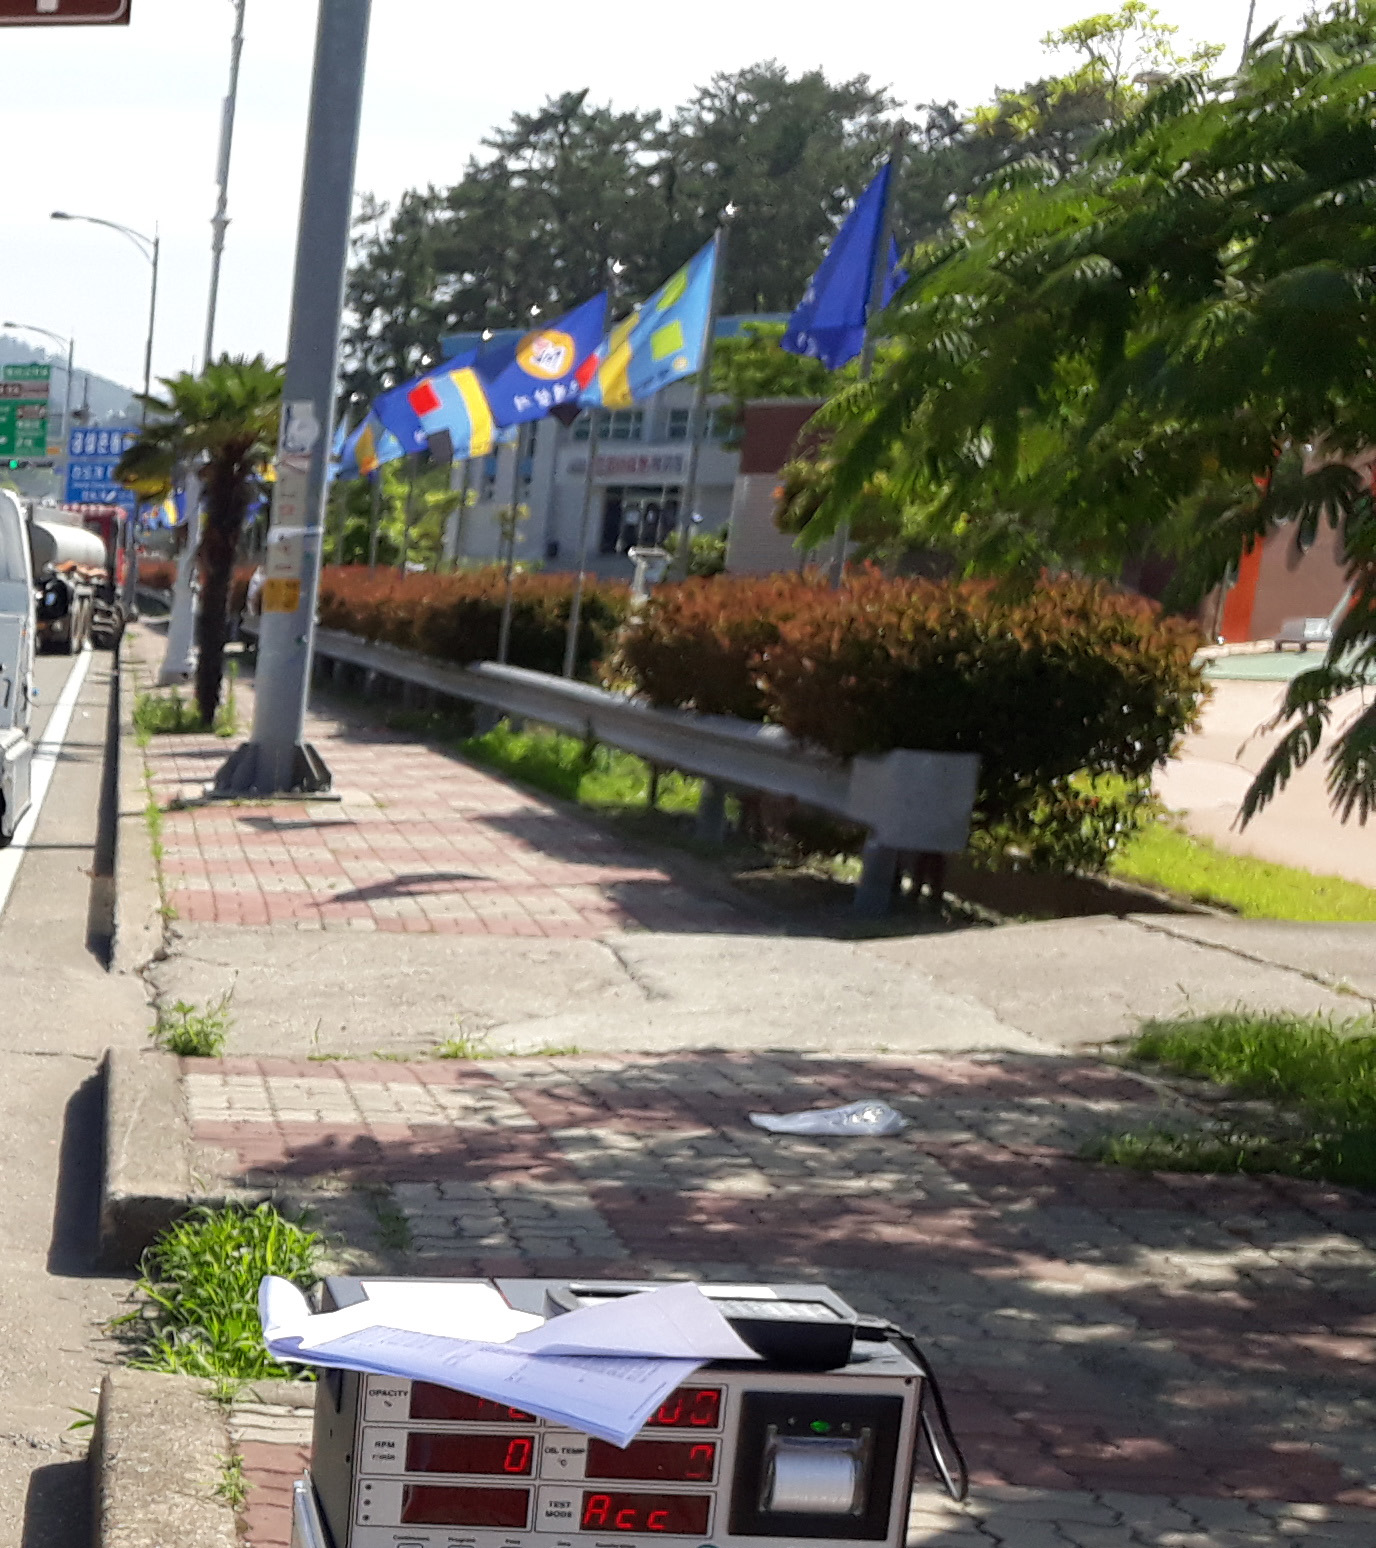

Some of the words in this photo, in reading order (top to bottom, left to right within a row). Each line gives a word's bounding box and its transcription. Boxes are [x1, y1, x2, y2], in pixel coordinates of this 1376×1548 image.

[368, 1388, 409, 1397] OPACITY
[374, 1440, 396, 1449] RPM
[504, 1438, 532, 1472] 0
[548, 1501, 572, 1509] TEST
